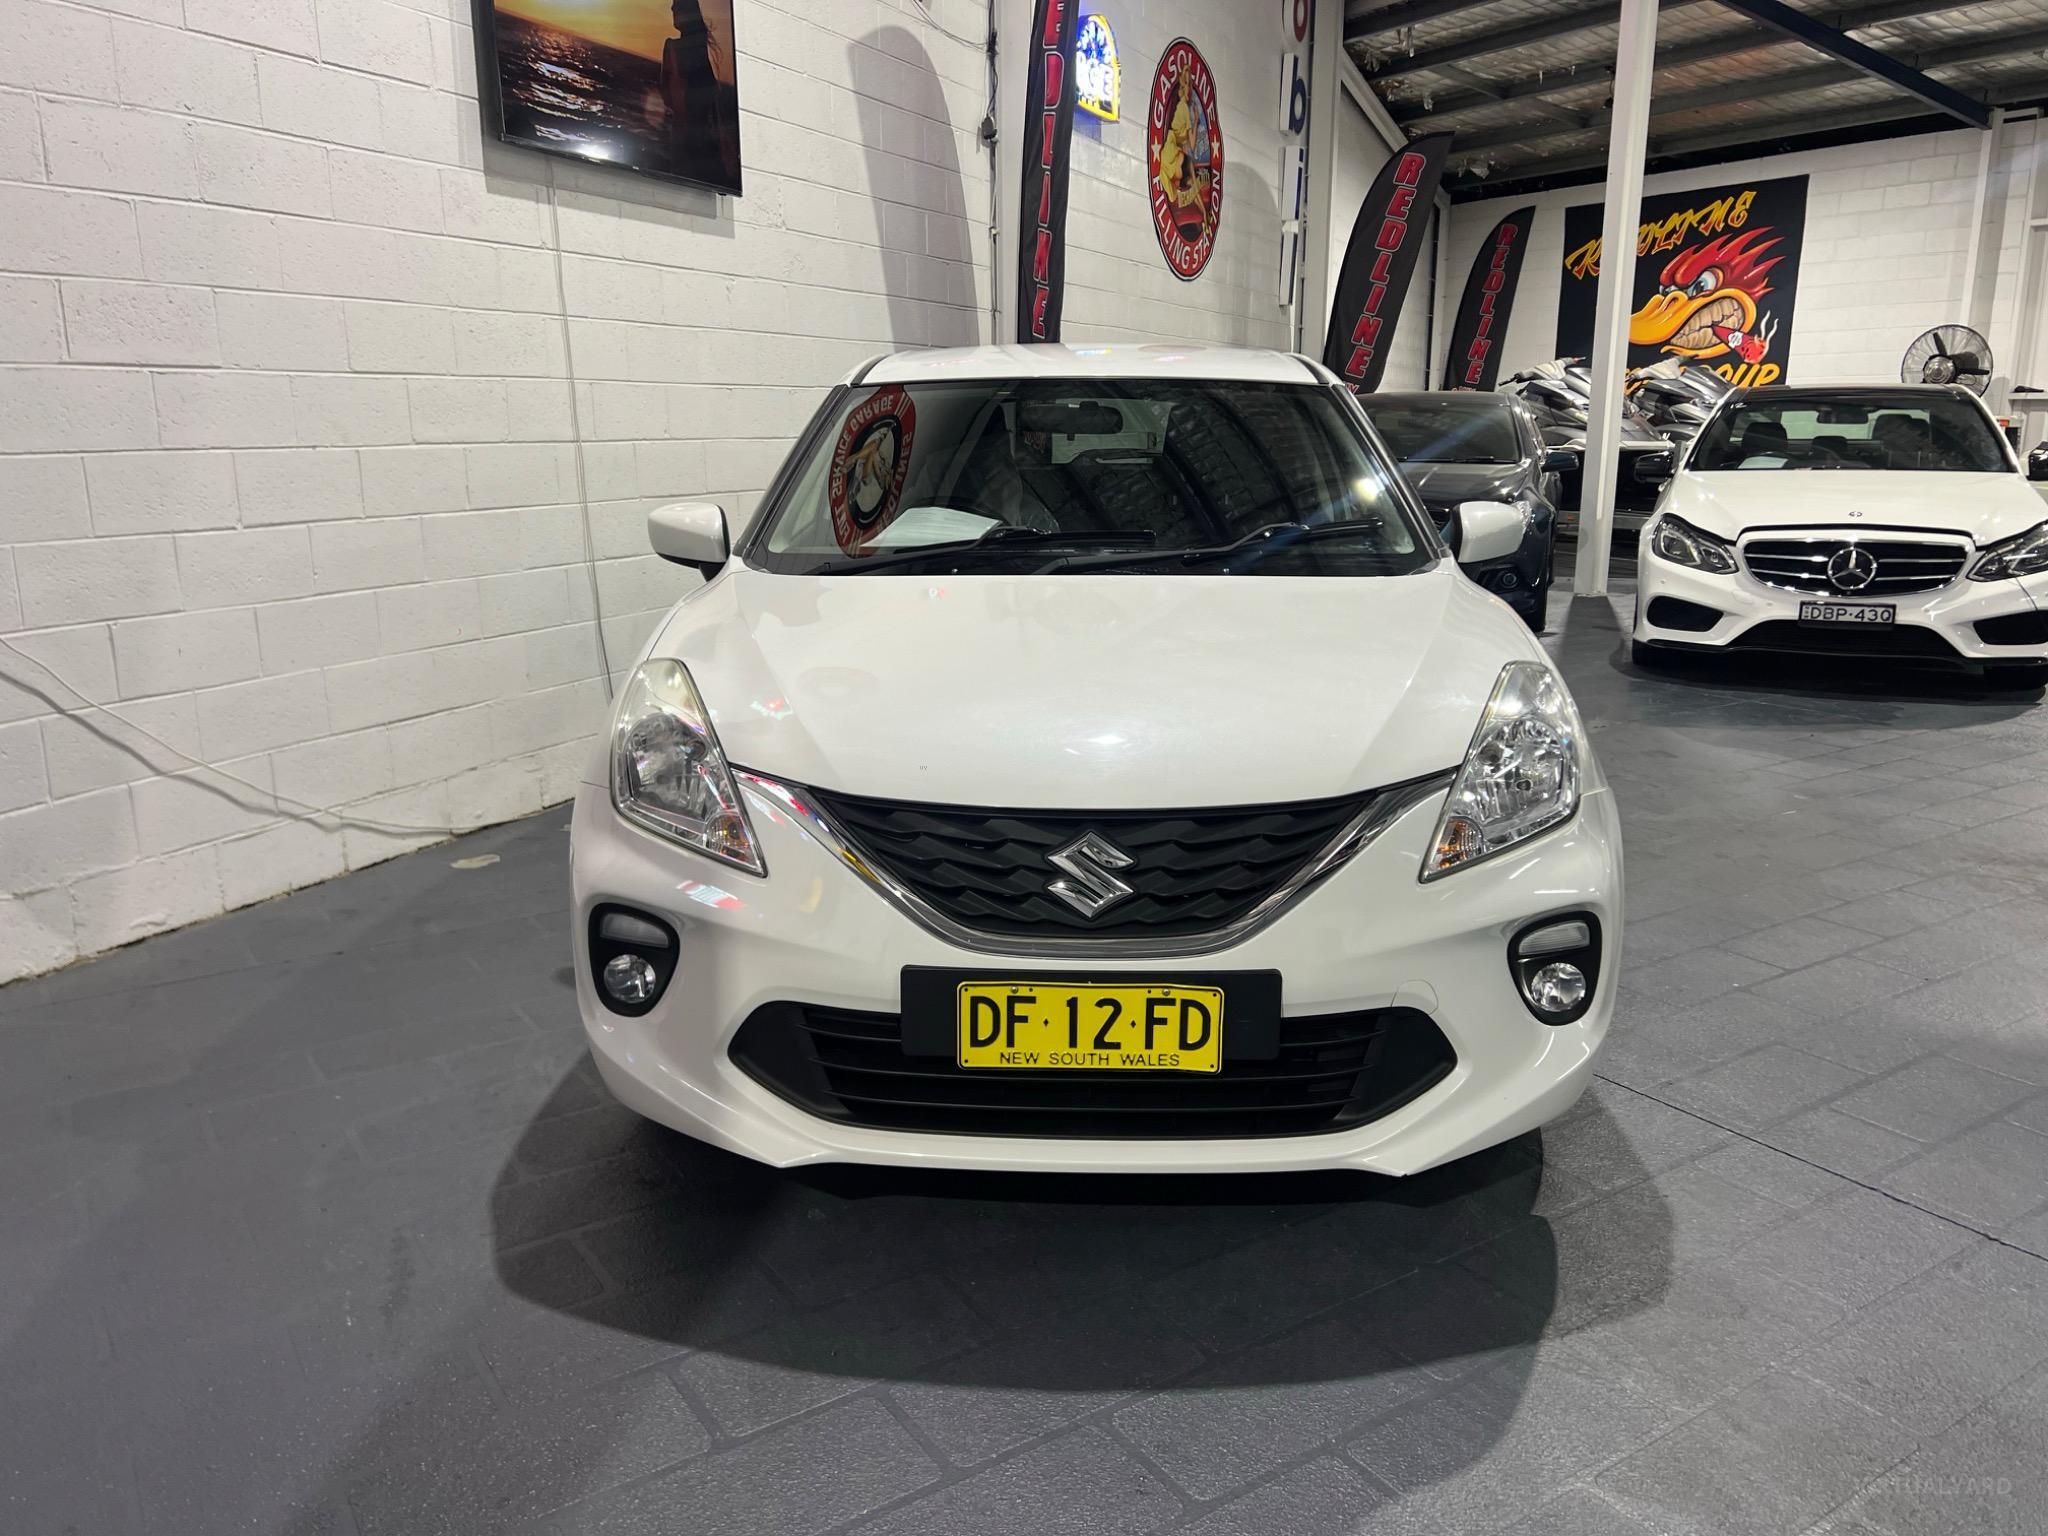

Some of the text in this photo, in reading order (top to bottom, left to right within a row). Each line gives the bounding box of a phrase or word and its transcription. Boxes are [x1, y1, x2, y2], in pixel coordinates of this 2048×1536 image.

[1154, 50, 1216, 129] GASOLINE
[1153, 175, 1190, 269] FILLING
[1345, 152, 1426, 378] REDLINE
[1564, 190, 1757, 280] RDLINE
[1465, 224, 1518, 384] REDLINE
[1000, 1052, 1180, 1067] NEW SOUTH WALES
